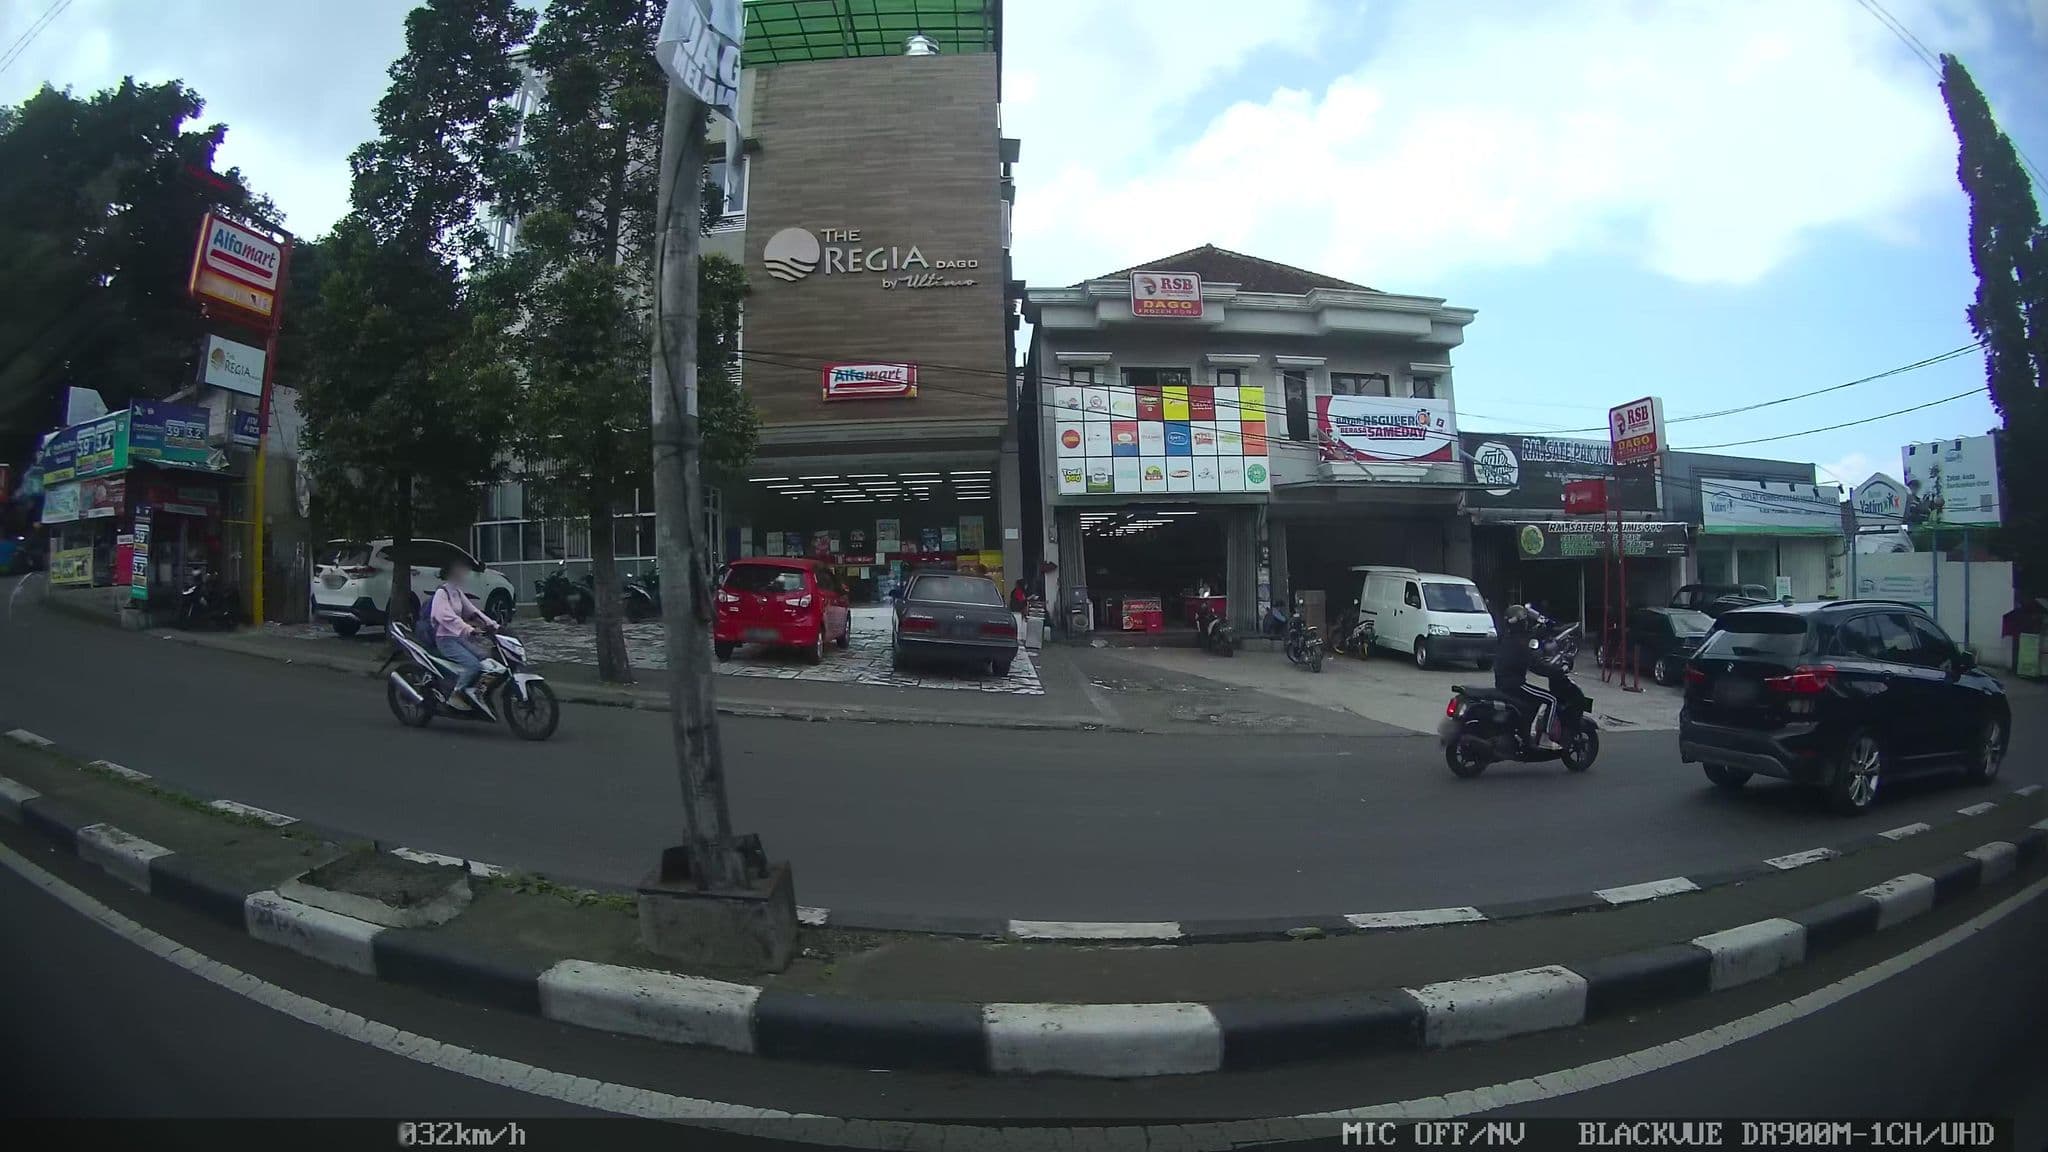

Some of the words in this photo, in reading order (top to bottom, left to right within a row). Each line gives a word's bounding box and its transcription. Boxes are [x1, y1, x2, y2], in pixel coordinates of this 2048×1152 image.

[821, 228, 861, 243] THE
[213, 228, 277, 268] Alfamart
[825, 245, 930, 274] REGIA
[935, 260, 978, 269] DAGO
[882, 278, 897, 289] by
[1160, 277, 1193, 290] RSB
[1143, 300, 1192, 309] DAGO
[224, 359, 251, 376] REGIA
[834, 368, 902, 382] Alfamart
[1363, 415, 1416, 427] REGULER
[1627, 405, 1649, 425] RSB
[1367, 426, 1425, 438] SAMEDAY
[1618, 435, 1650, 450] DAGO
[1545, 439, 1571, 463] SATE
[1859, 498, 1883, 514] Yatim
[1569, 523, 1593, 533] SATE
